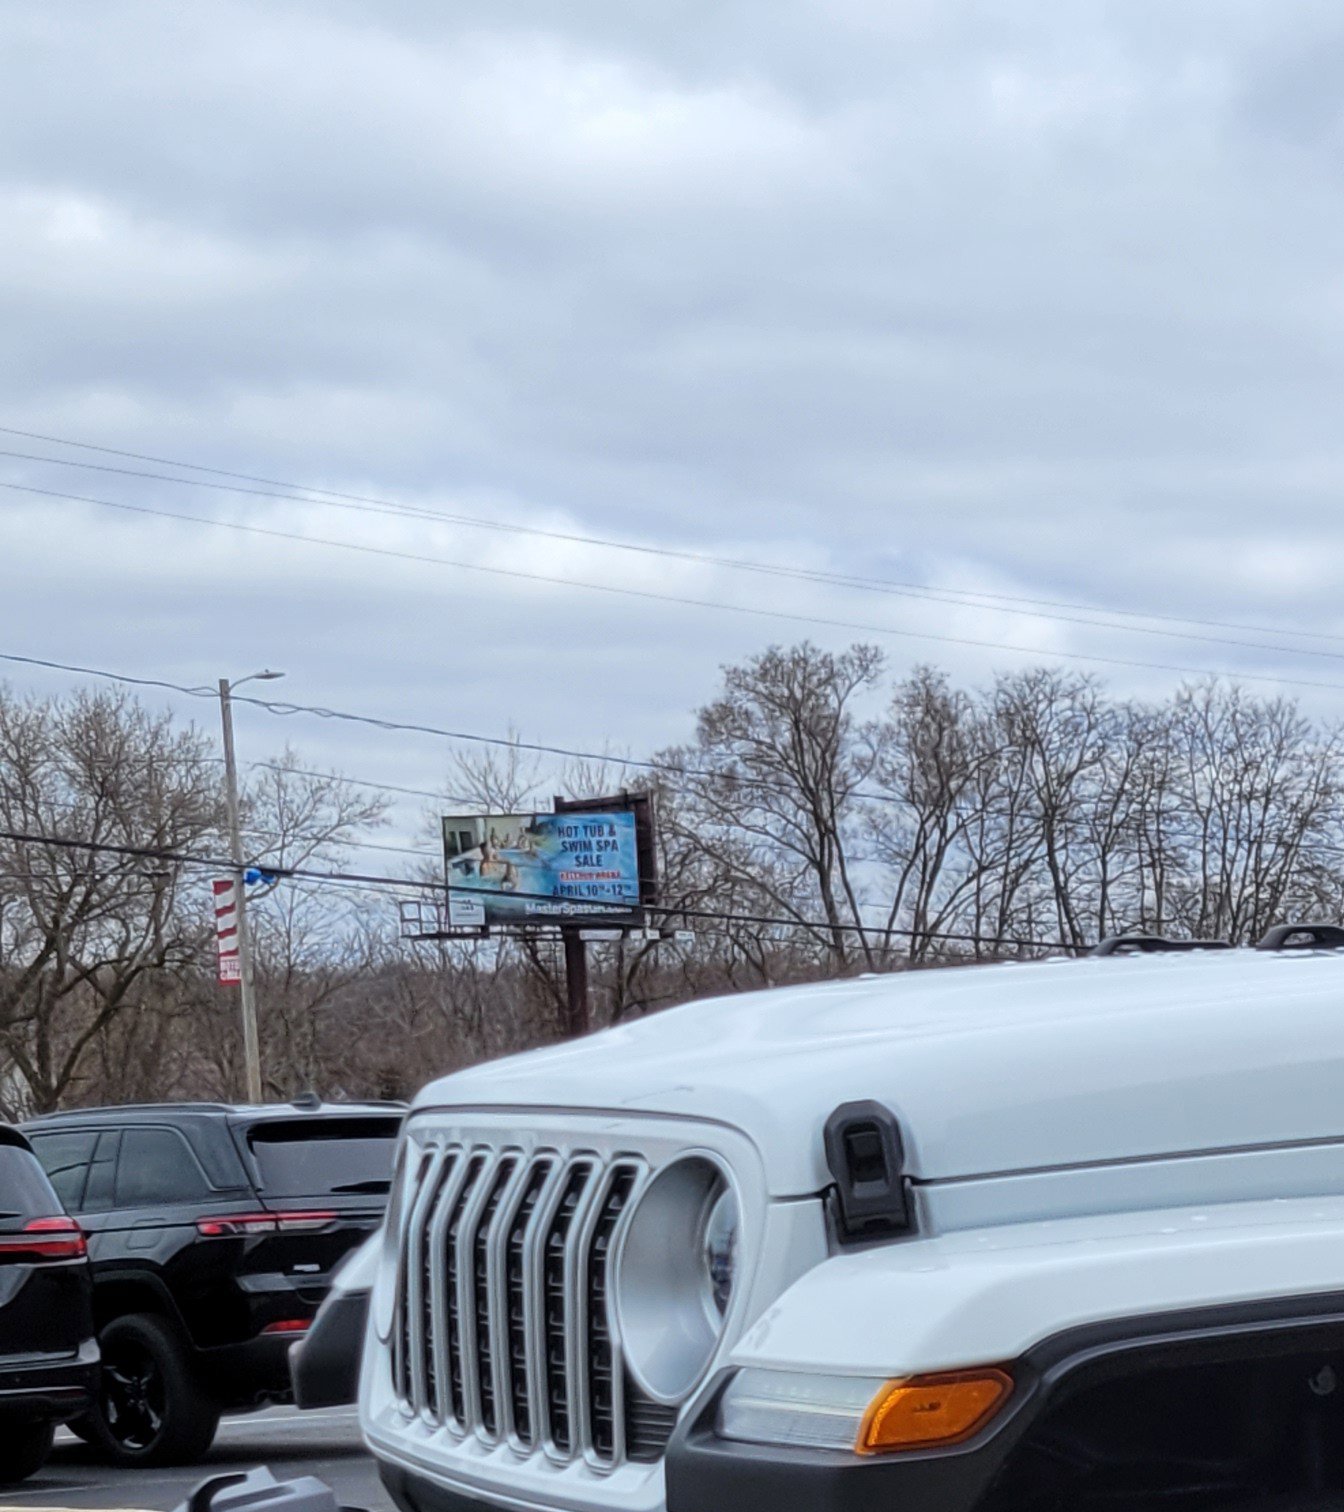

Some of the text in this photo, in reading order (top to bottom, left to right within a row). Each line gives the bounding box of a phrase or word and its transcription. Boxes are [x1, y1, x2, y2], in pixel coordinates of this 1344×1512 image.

[557, 822, 617, 838] HOT TUB &
[561, 839, 619, 853] SWIM SPA
[574, 855, 603, 868] SALE
[552, 884, 584, 897] APRIL
